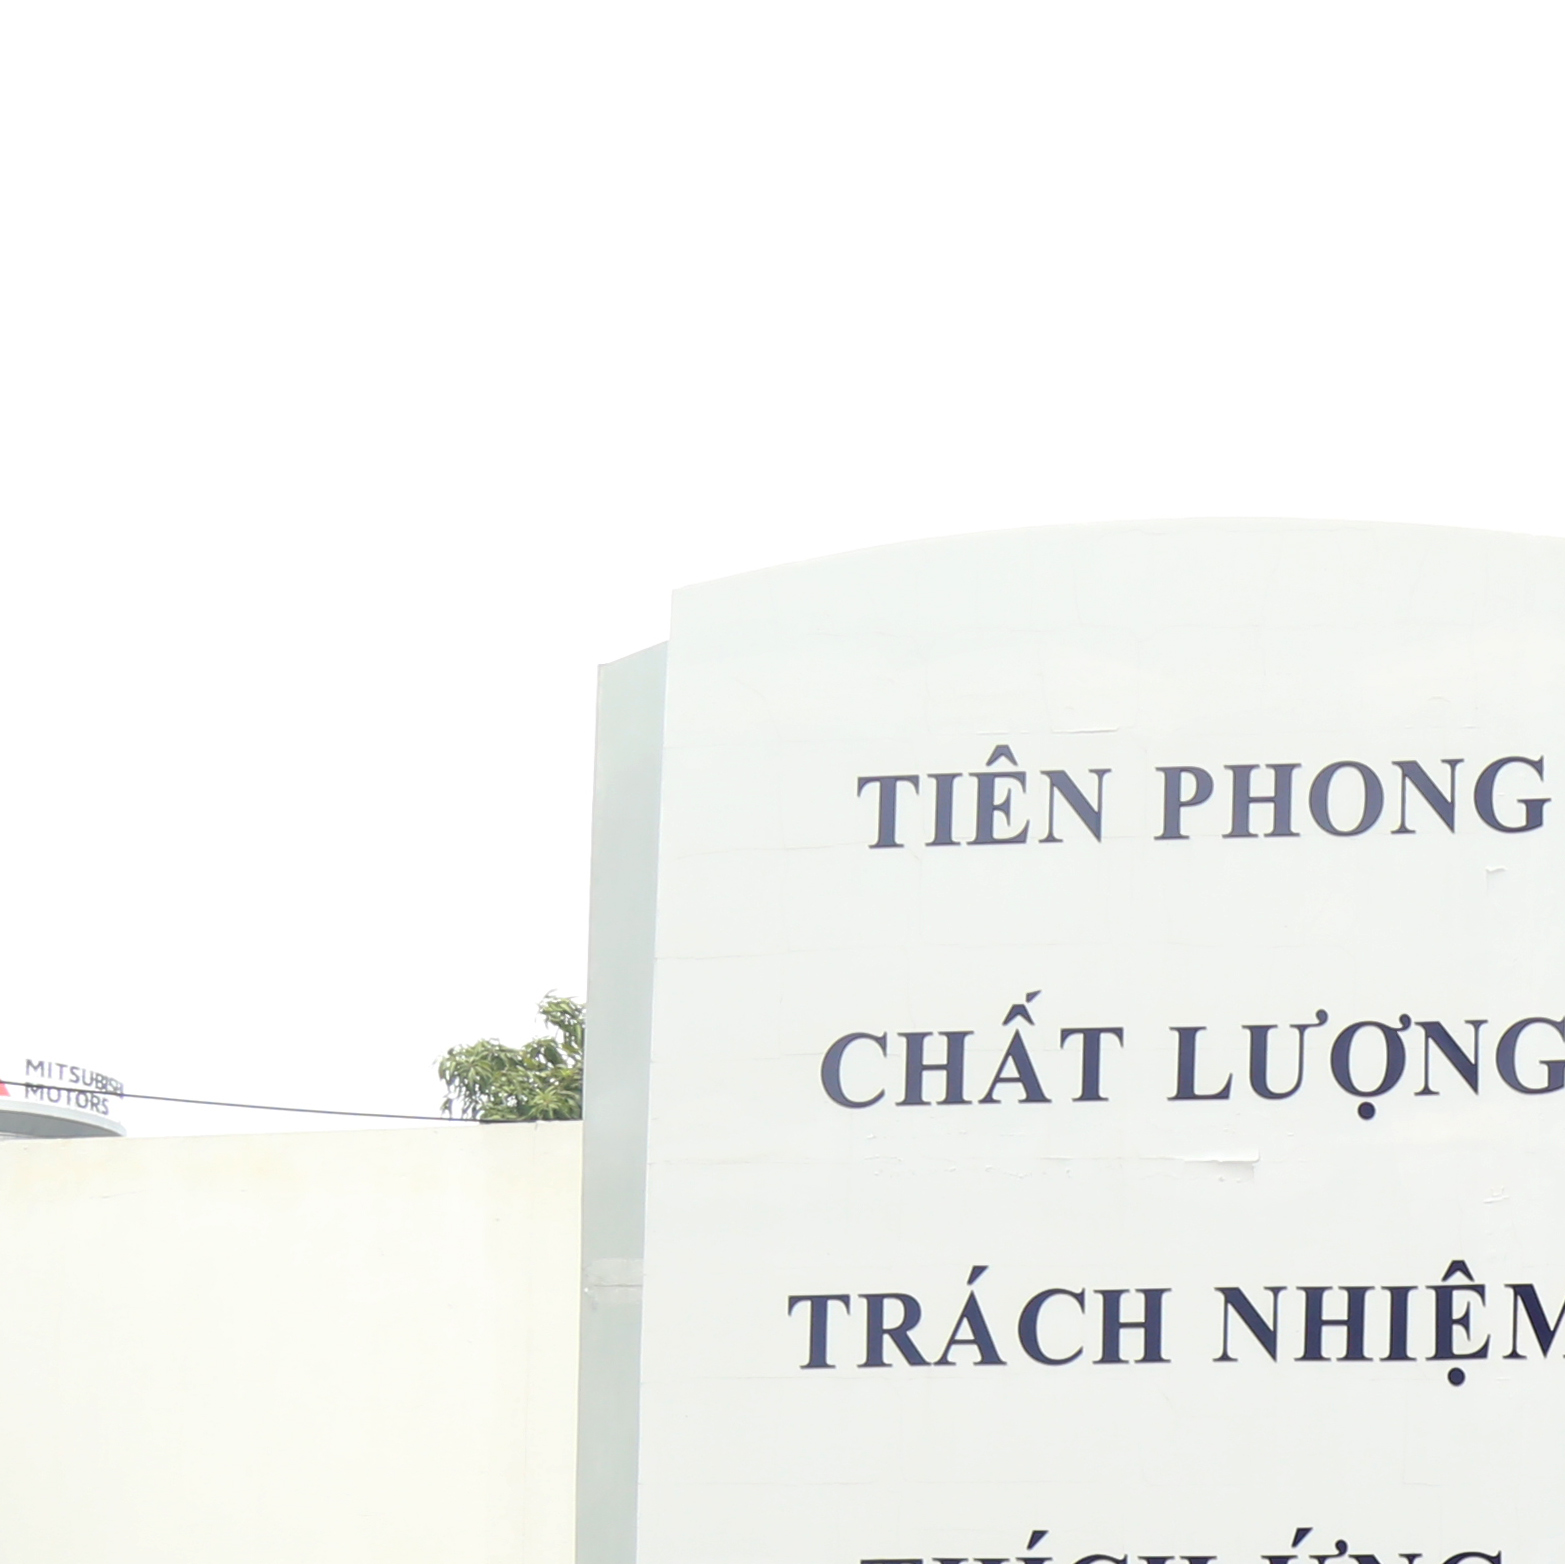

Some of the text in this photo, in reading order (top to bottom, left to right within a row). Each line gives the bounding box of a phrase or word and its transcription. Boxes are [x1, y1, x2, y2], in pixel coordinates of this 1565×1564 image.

[857, 744, 1552, 849] TIÊN PHONG
[25, 1082, 109, 1115] MOTORS
[820, 989, 1125, 1109] CHẤT
[787, 1265, 1172, 1370] TRÁCH
